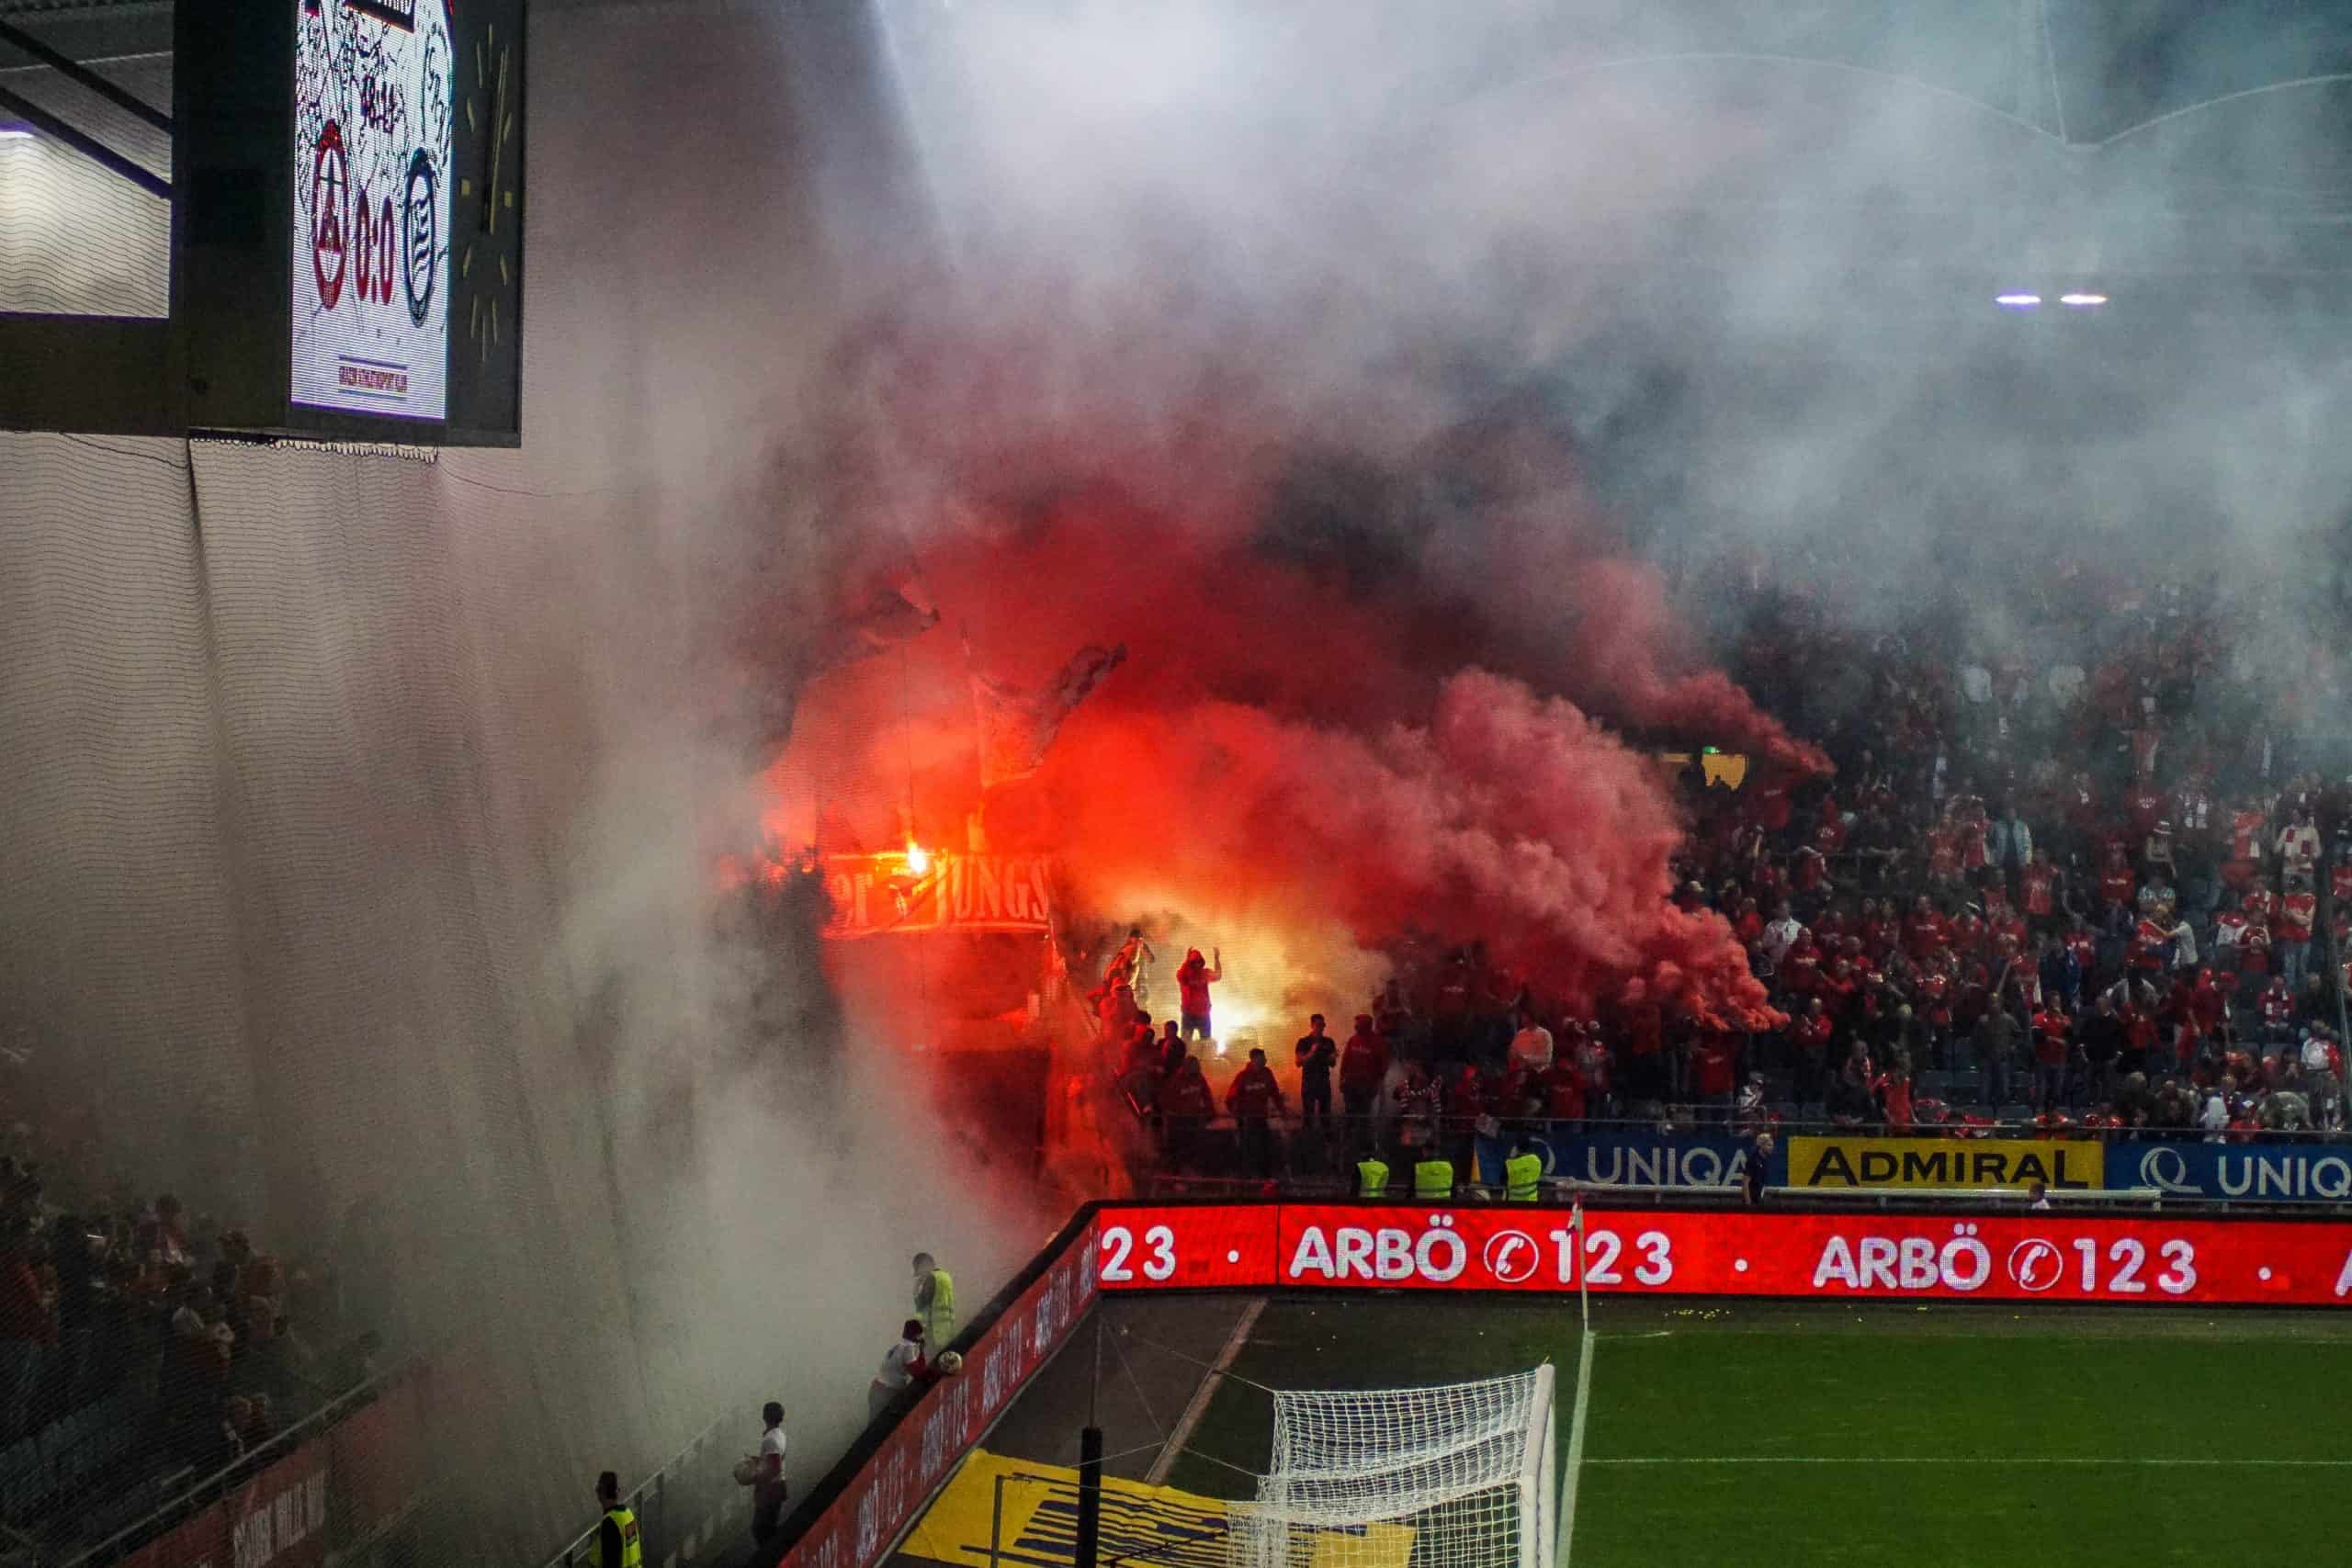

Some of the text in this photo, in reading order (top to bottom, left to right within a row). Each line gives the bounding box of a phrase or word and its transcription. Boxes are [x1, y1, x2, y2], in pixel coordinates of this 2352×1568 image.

[1807, 1145, 2089, 1188] ADMIRAL
[1101, 1224, 1177, 1281] 23
[1288, 1213, 1674, 1286] ARBÖ 123
[1812, 1222, 2199, 1294] ARBÖ 123
